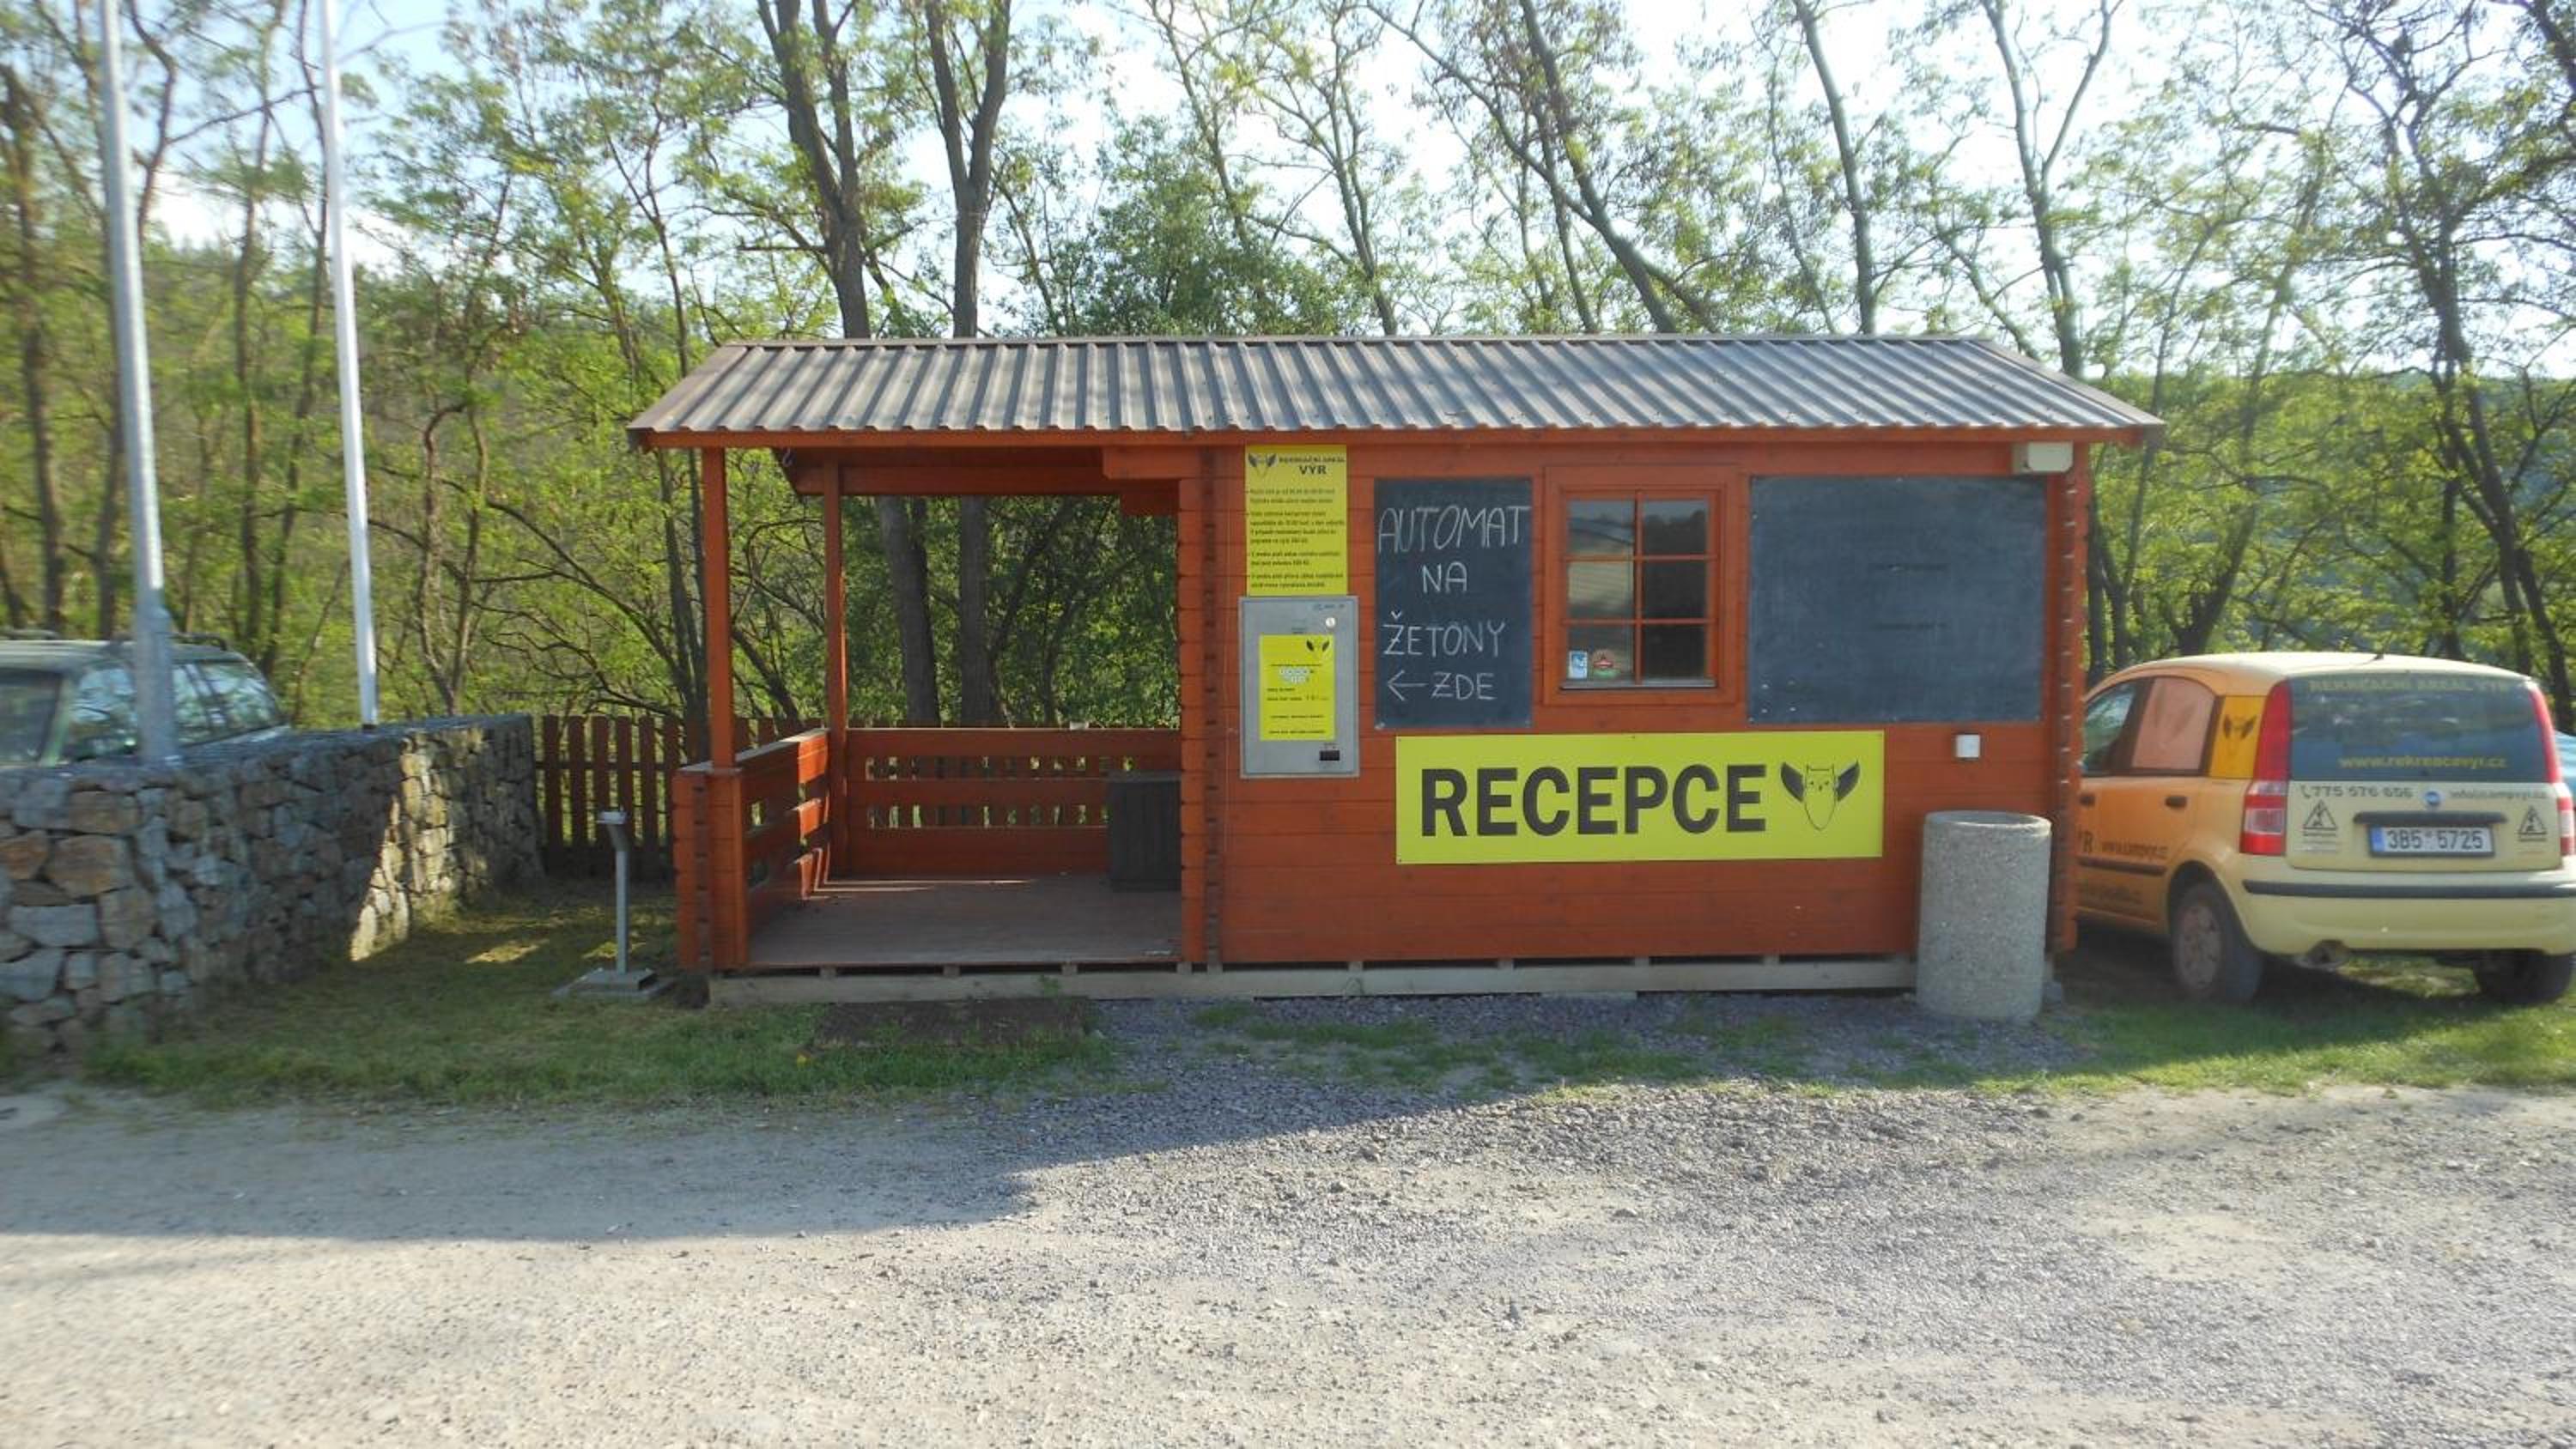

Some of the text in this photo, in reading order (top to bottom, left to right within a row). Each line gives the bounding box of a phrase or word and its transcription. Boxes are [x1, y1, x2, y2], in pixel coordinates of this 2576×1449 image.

[1377, 505, 1532, 554] AUTOMAT
[1421, 561, 1467, 593] NA
[1381, 609, 1506, 658] ŽETONY
[1431, 671, 1498, 700] ZDE
[1421, 763, 1767, 837] RECEPCE
[2436, 829, 2484, 850] 5725
